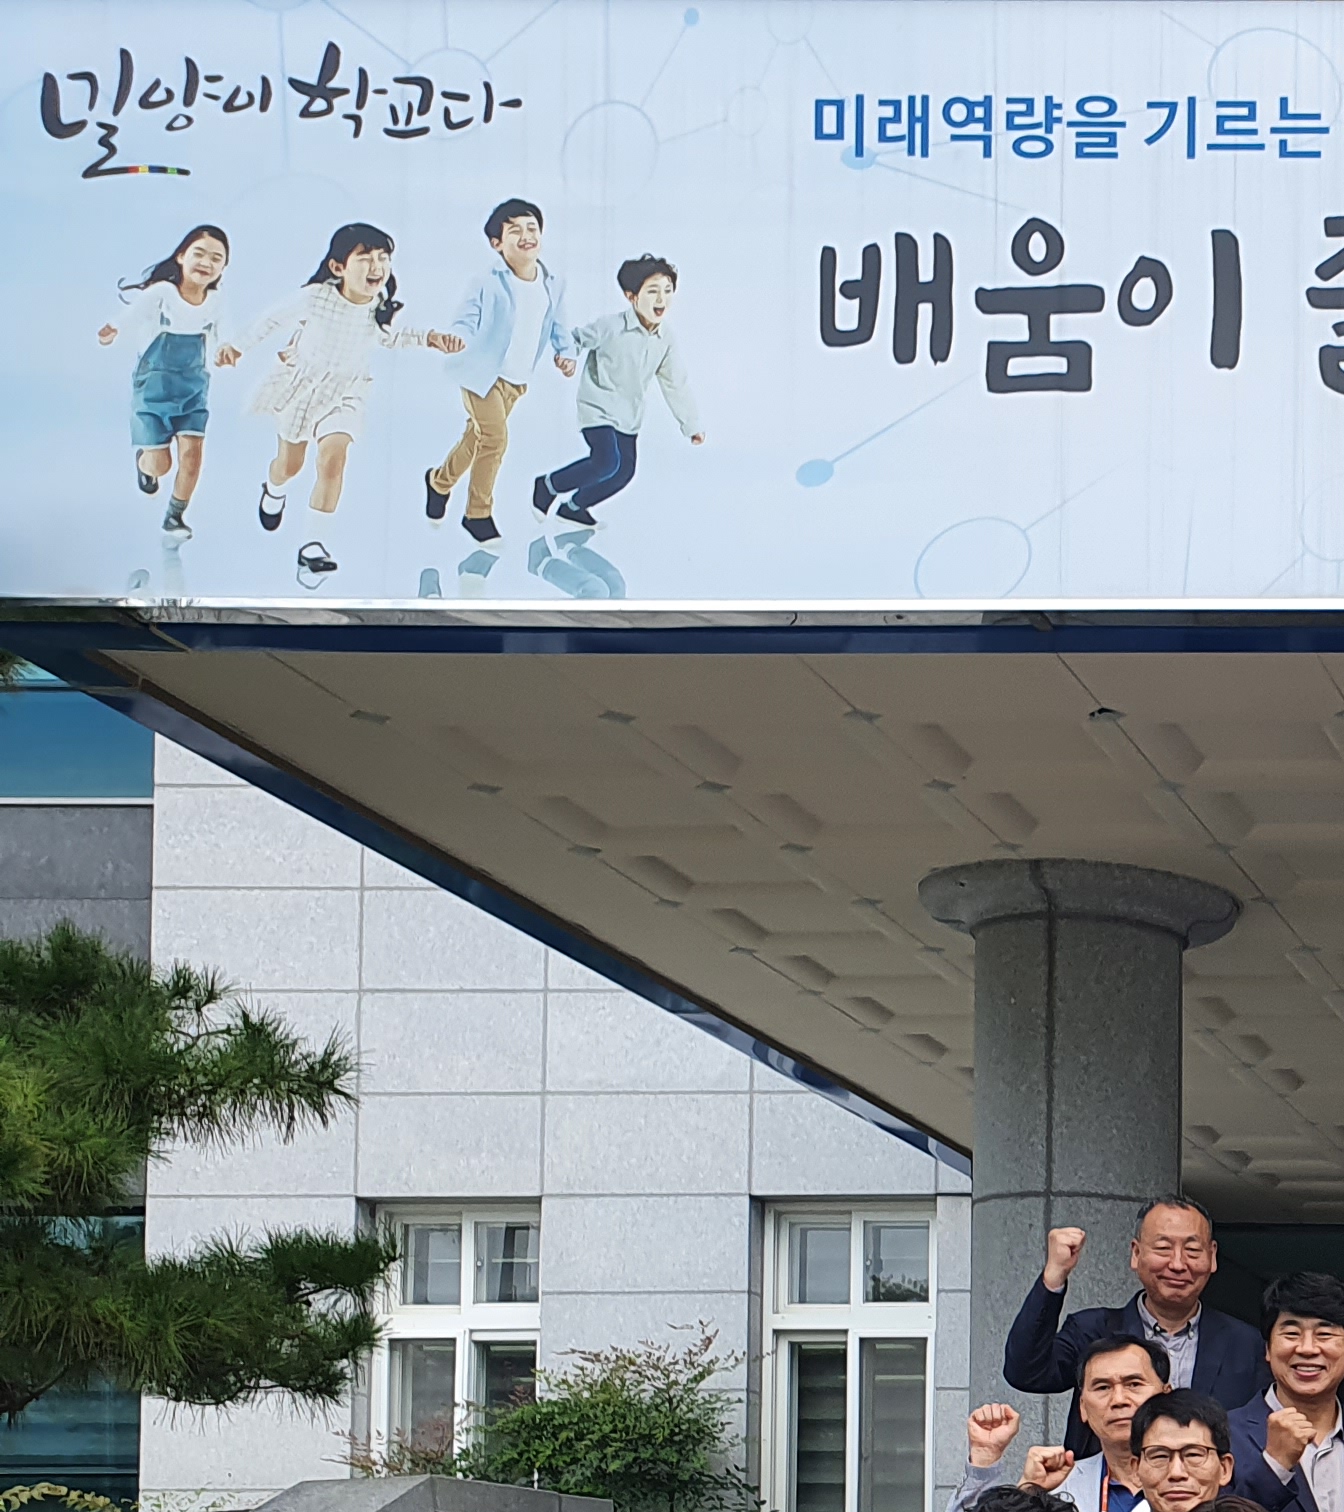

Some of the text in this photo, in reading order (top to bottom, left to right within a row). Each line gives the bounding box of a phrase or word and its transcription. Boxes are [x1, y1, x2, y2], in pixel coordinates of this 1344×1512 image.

[39, 40, 523, 180] 밀양이 학교다
[814, 93, 1127, 159] 미래역량을
[1143, 96, 1331, 160] 기르는
[819, 216, 1243, 394] 배움이
